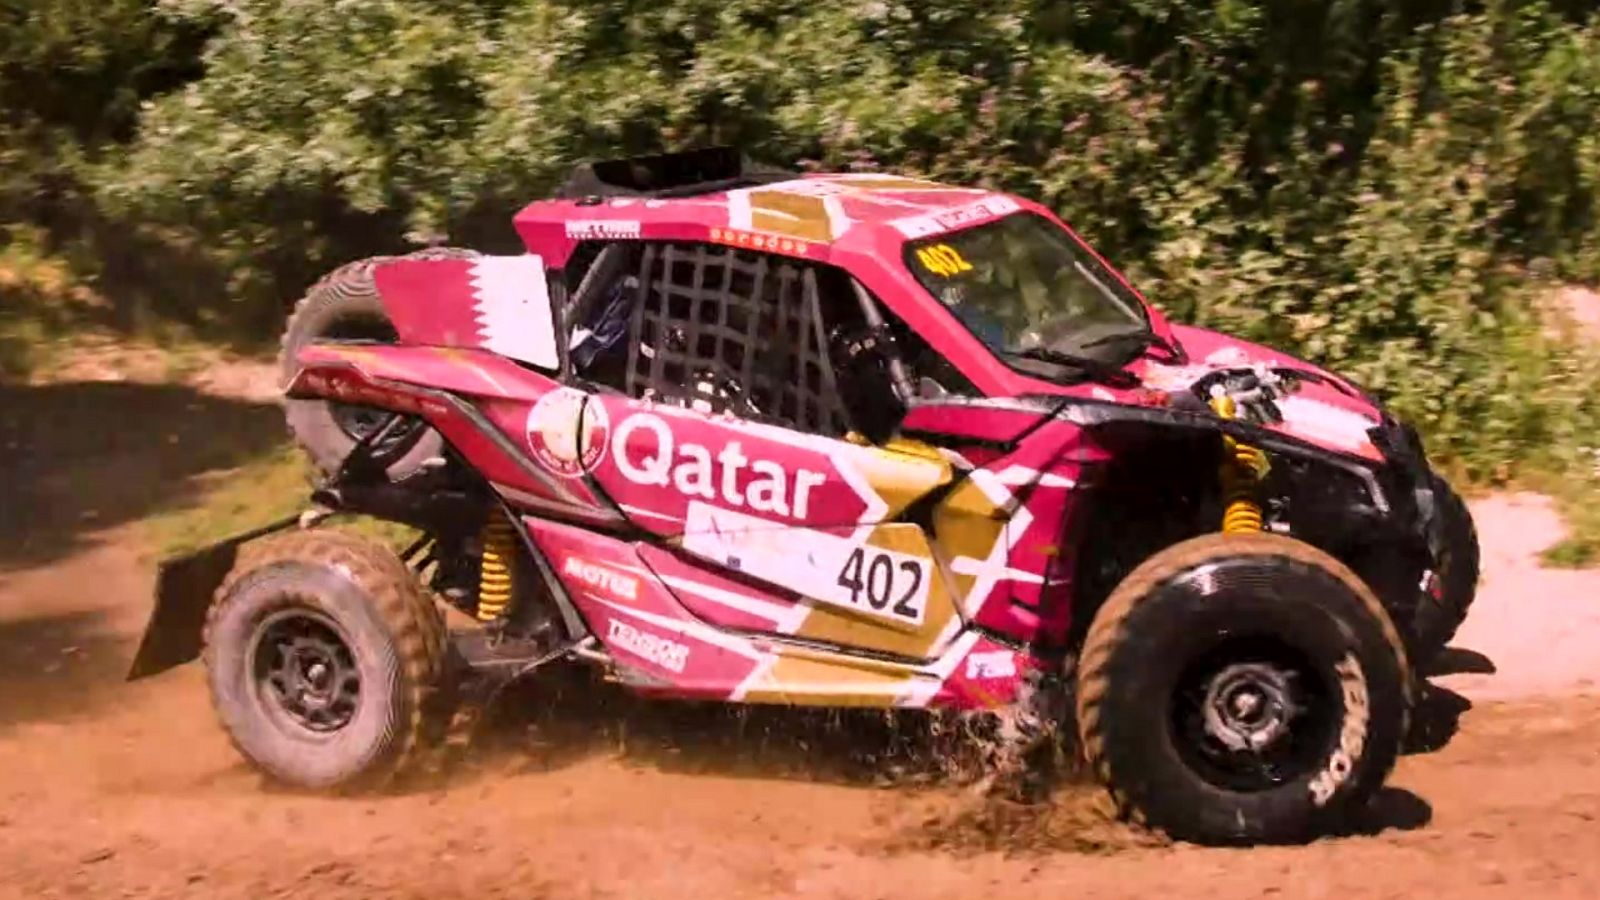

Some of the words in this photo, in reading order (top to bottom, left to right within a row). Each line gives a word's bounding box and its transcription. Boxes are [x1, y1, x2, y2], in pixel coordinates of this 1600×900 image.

[915, 243, 973, 277] 402
[612, 413, 827, 519] Qatar
[837, 547, 923, 619] 402
[607, 617, 690, 674] TENSOR
[1307, 651, 1370, 807] TENSOR
